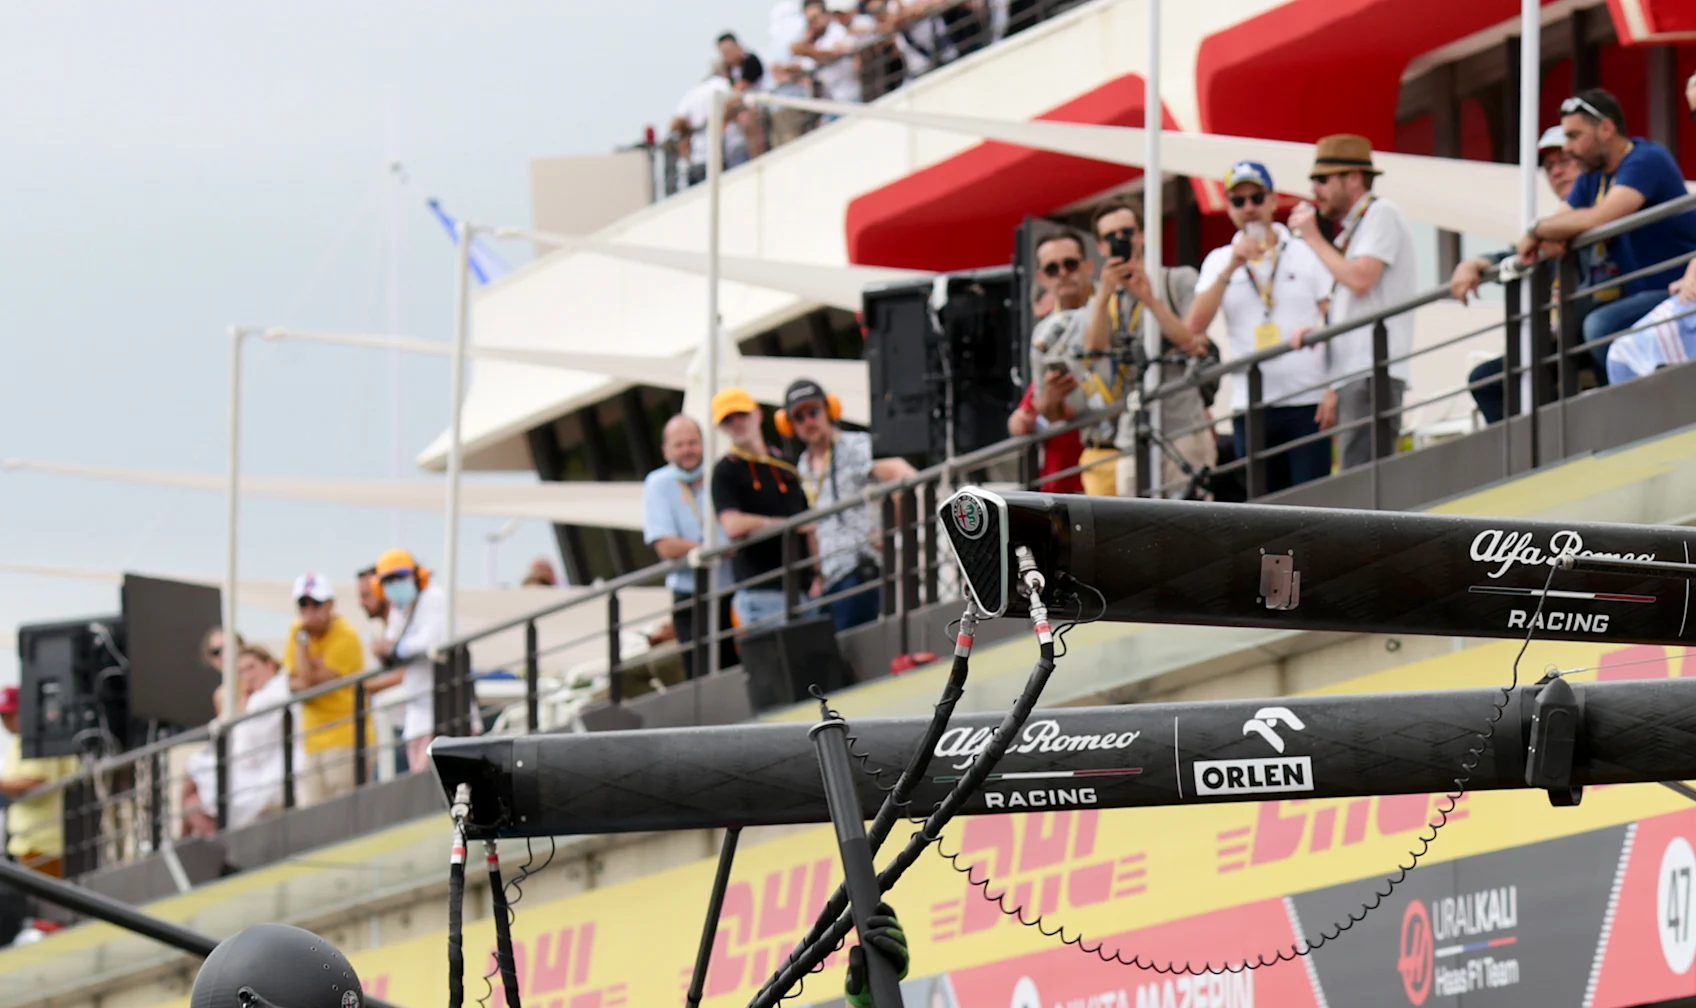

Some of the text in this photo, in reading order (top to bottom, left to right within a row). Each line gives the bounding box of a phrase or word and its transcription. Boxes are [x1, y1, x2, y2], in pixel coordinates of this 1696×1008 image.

[1469, 529, 1547, 578] Alfa
[1508, 609, 1610, 633] RACING
[1021, 720, 1141, 754] Romeo
[985, 787, 1098, 808] RACING
[1202, 763, 1304, 791] ORLEN
[961, 809, 1116, 934] DHL
[1432, 885, 1518, 940] URALKALI
[1667, 868, 1692, 943] 47
[1435, 966, 1467, 998] Haas
[1485, 957, 1519, 989] Team
